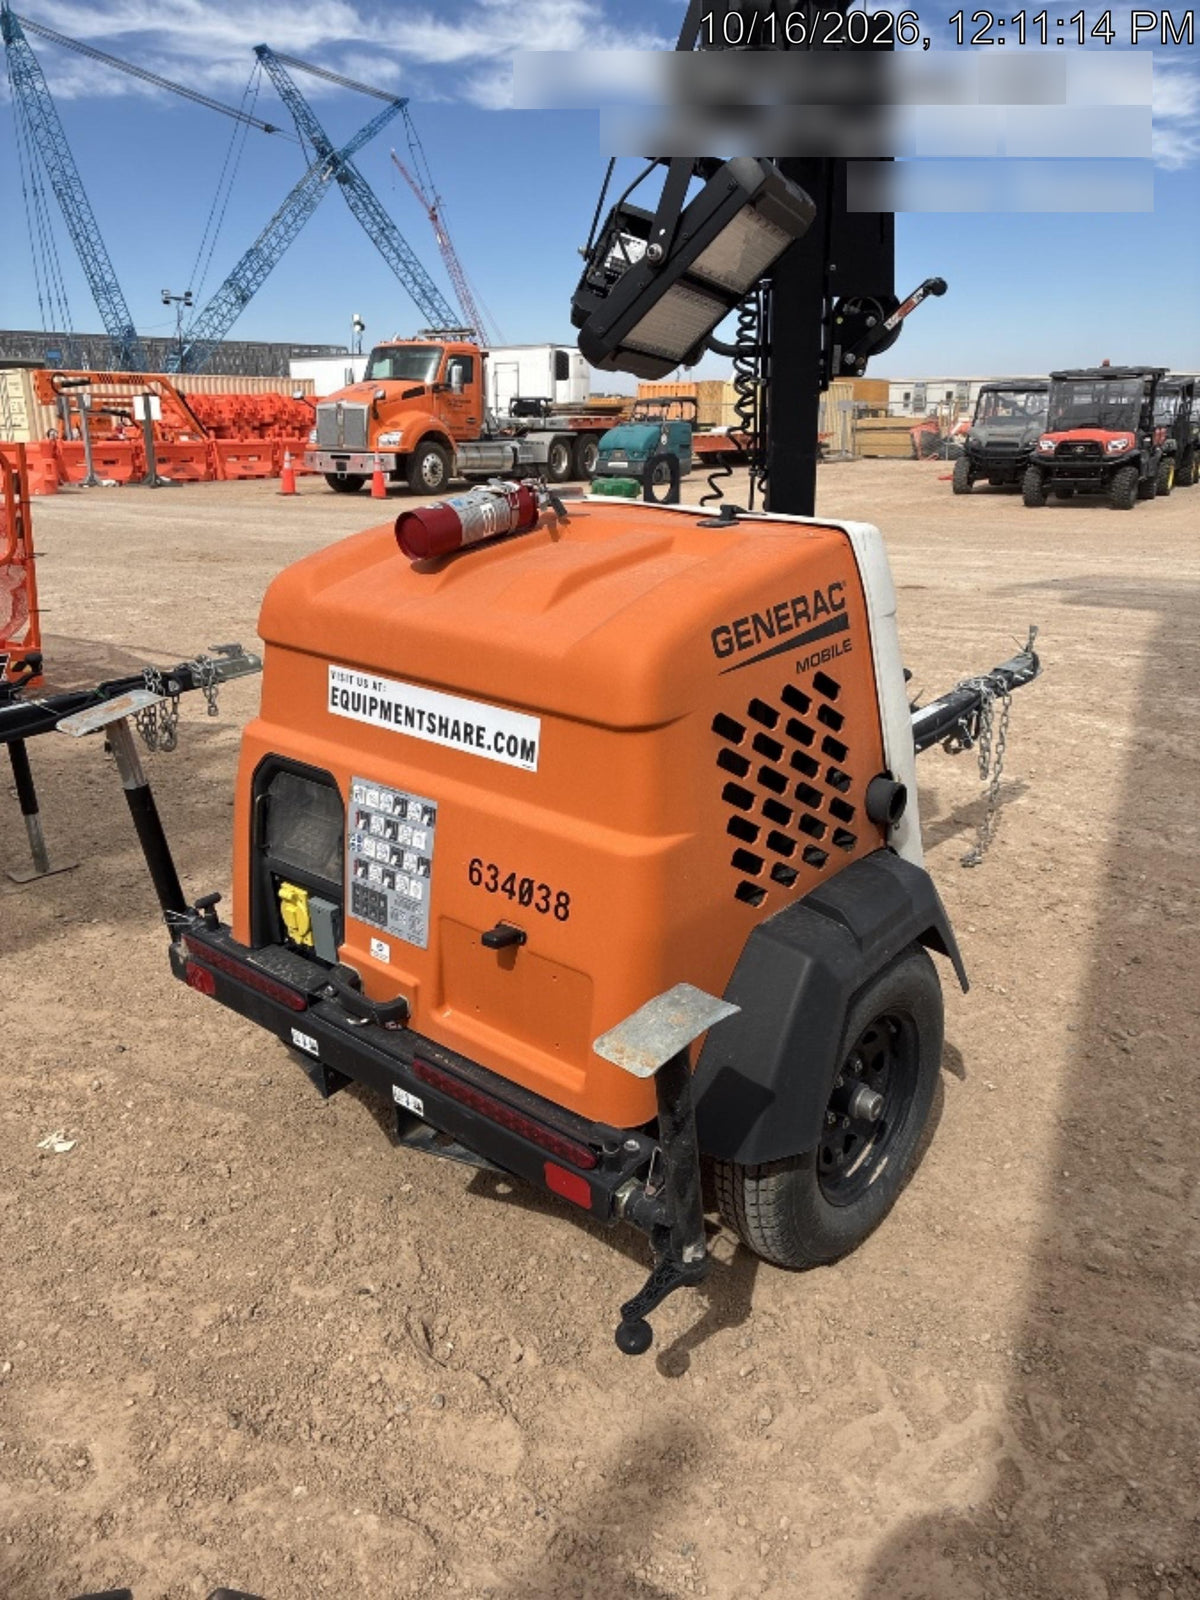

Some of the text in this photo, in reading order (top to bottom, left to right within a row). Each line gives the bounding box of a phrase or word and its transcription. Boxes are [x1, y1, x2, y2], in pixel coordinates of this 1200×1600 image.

[711, 582, 846, 659] GENERAC
[330, 670, 387, 692] VISIT US AT:
[796, 638, 853, 674] MOBILE
[331, 686, 536, 764] EQUIPMENTSHARE.COM
